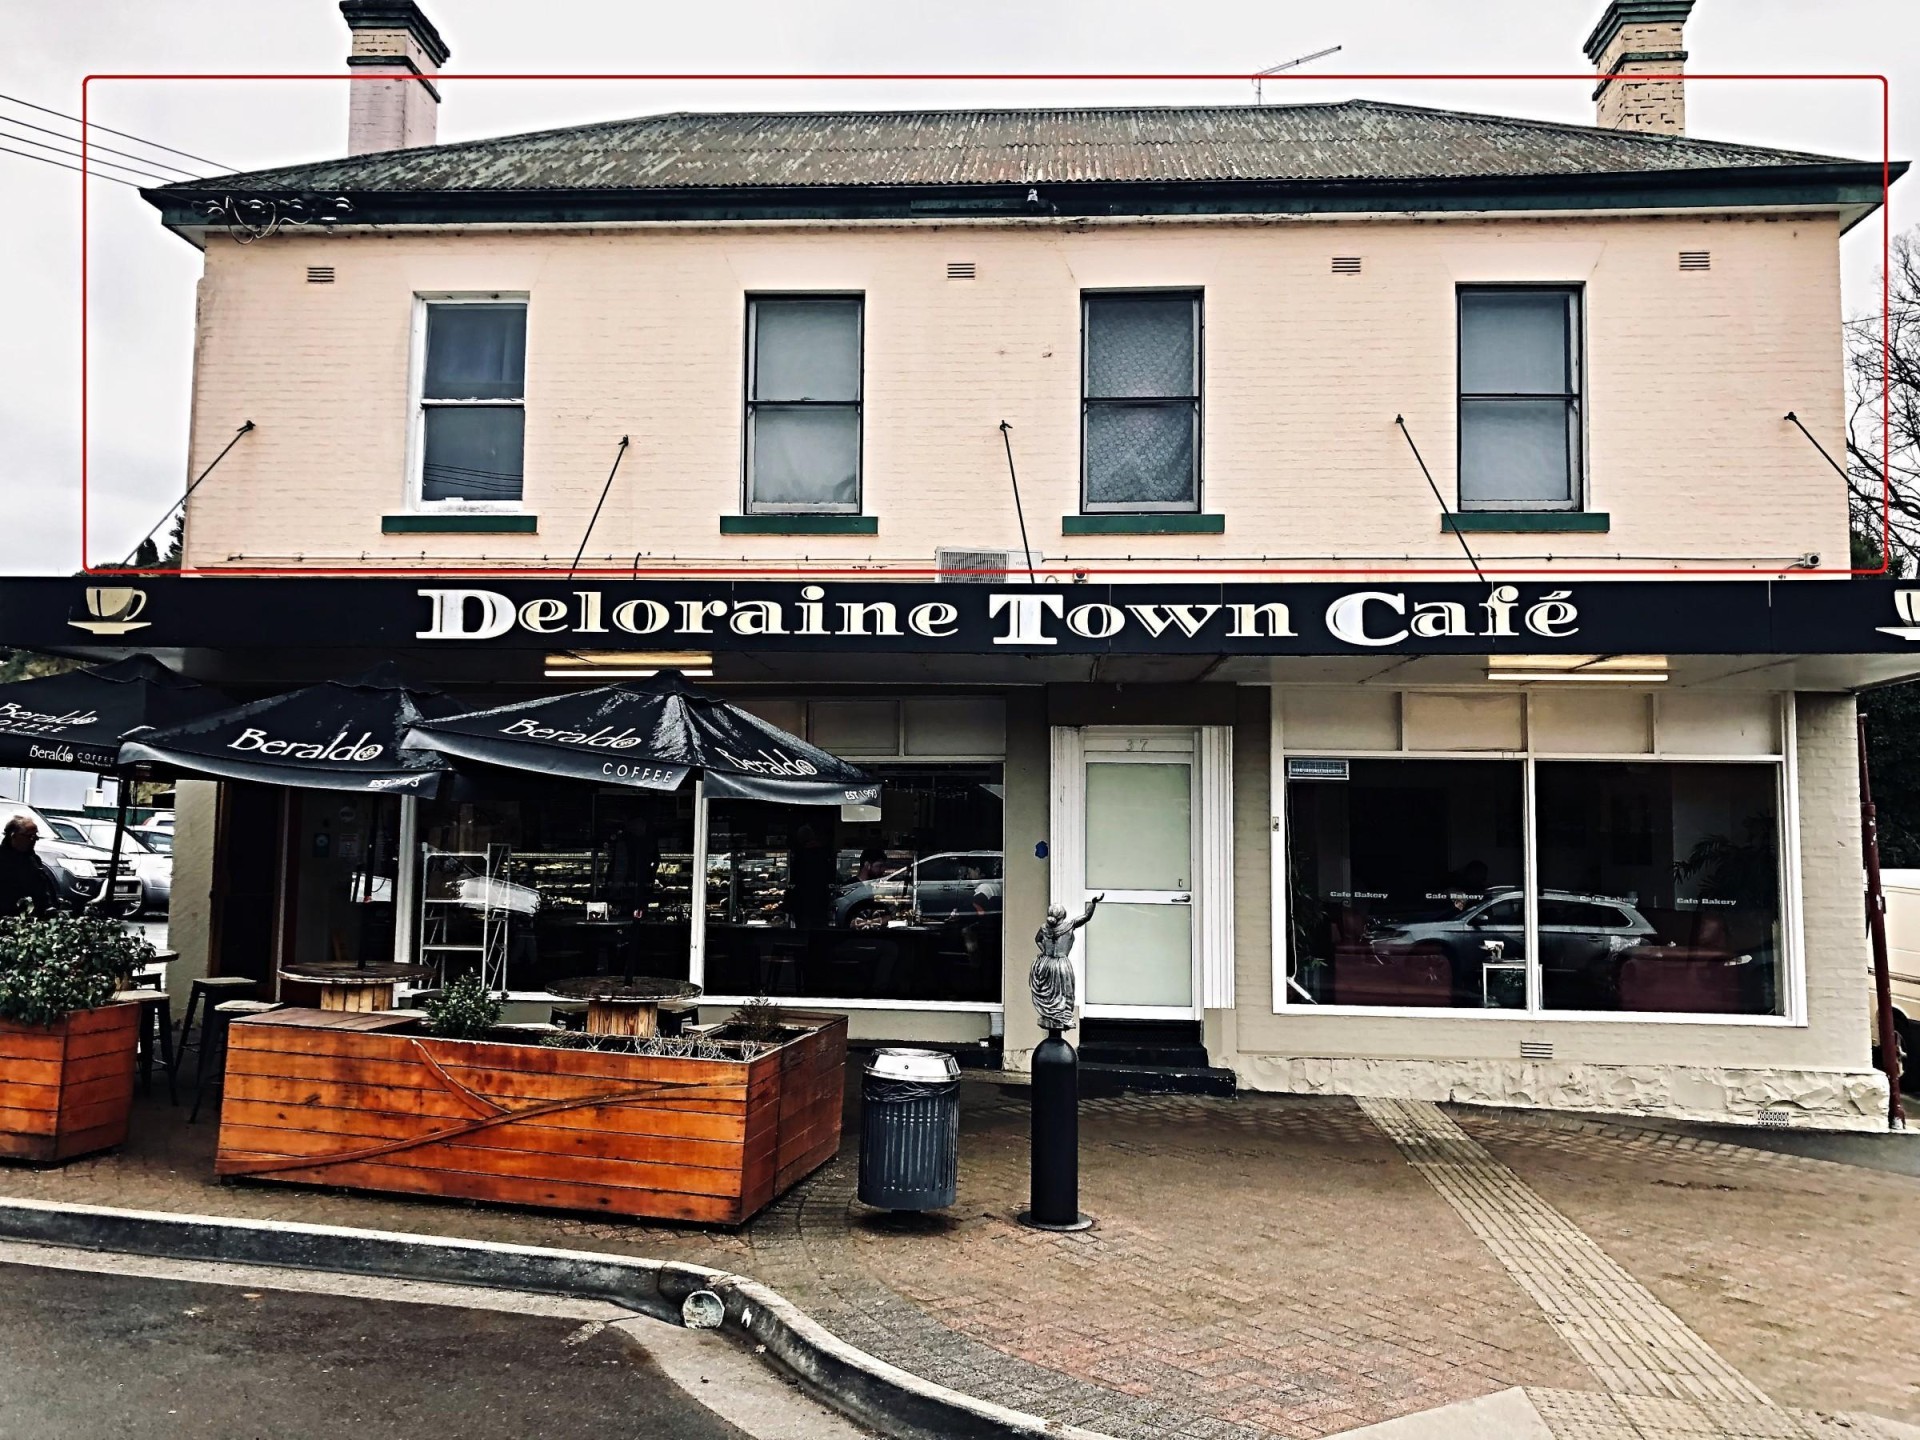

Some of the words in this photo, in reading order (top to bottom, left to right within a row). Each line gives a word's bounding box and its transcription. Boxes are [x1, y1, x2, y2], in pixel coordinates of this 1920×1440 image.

[416, 585, 959, 640] Deloraine
[989, 593, 1298, 645] Town
[1325, 585, 1579, 647] Café
[0, 703, 98, 724] Beraldo
[227, 728, 383, 761] Beraldo
[499, 719, 642, 749] Beraldo
[29, 744, 73, 762] Beraldo
[77, 751, 115, 763] COFFEE
[715, 747, 817, 776] Beraldo
[602, 763, 673, 783] COFFEE
[1354, 891, 1388, 899] Bakery
[1701, 898, 1737, 906] Bakery
